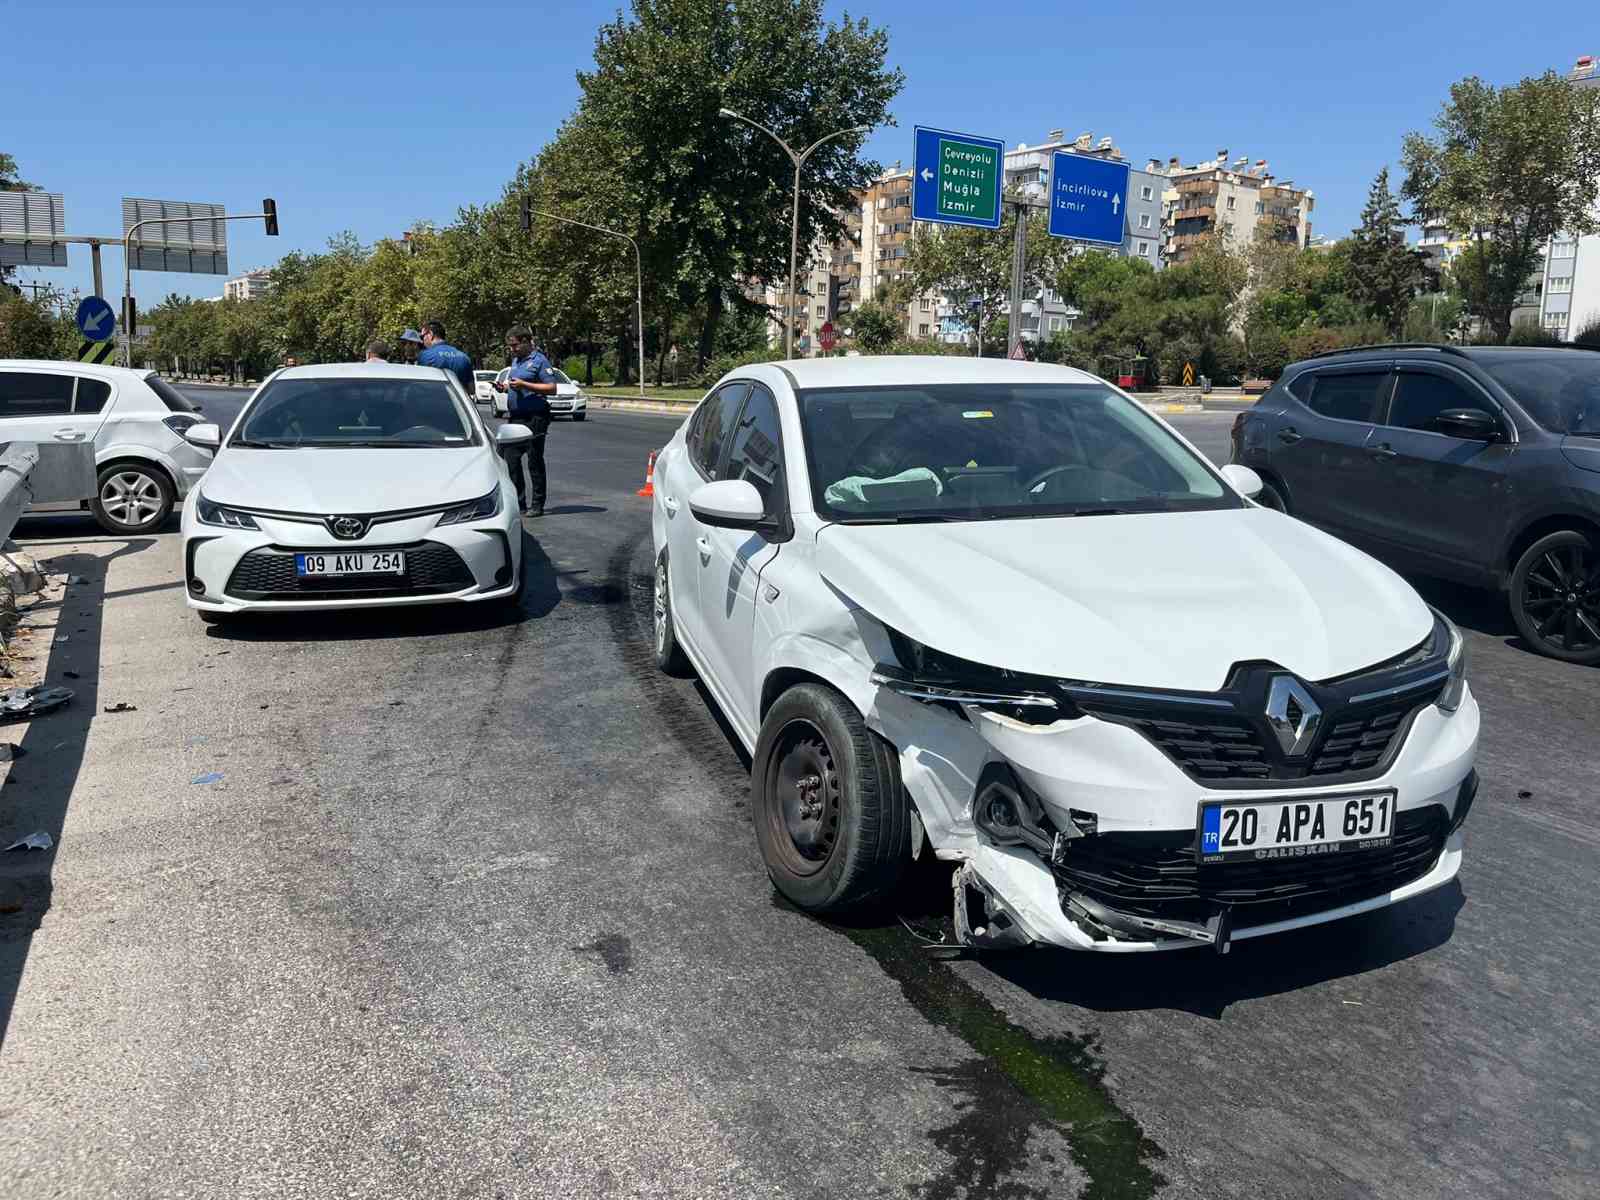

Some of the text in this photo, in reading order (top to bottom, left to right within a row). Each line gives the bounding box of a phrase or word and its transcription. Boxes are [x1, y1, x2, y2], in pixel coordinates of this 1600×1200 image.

[945, 147, 991, 164] Çevreyolu
[944, 163, 984, 179] Denizli
[943, 181, 980, 197] Muğla
[1057, 177, 1108, 198] İncirliova
[943, 195, 976, 212] İzmir
[1056, 194, 1086, 212] İzmir
[306, 554, 400, 572] 09 AKU 254
[1221, 797, 1390, 847] 20 APA 651
[1203, 831, 1218, 843] TR
